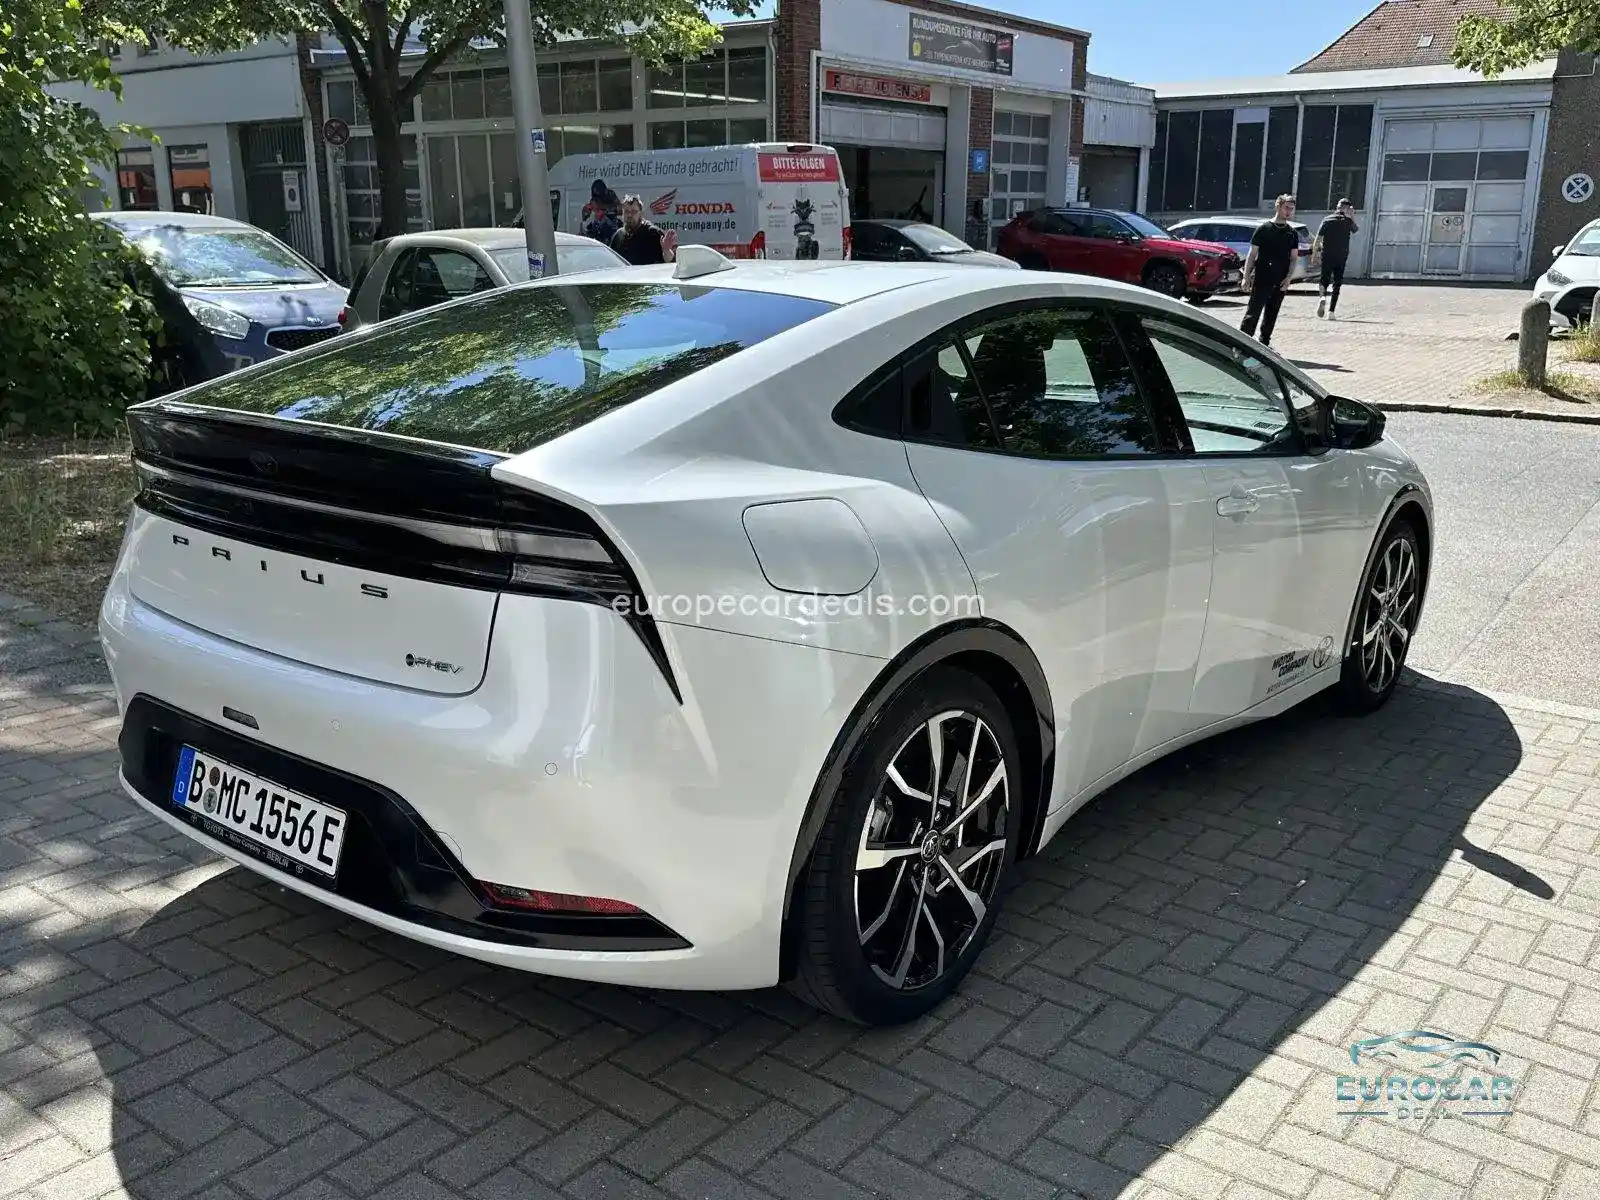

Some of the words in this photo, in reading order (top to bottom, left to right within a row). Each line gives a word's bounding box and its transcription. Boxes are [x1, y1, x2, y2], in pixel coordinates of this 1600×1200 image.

[913, 18, 960, 37] RUNDUMSERVICE
[961, 25, 972, 40] FÜR
[982, 33, 996, 43] AUTO
[579, 165, 598, 179] Hier
[600, 162, 620, 178] wird
[622, 160, 652, 177] DEINE
[655, 159, 686, 175] Honda
[688, 157, 738, 177] gebracht!
[772, 157, 796, 169] BITTE
[796, 157, 825, 170] FOLGEN
[675, 203, 735, 215] HONDA
[173, 535, 388, 599] PRIUS
[415, 656, 463, 675] PHEV
[1272, 650, 1296, 670] MOTOR
[1279, 652, 1310, 678] COMPANY
[188, 759, 206, 803] B
[203, 817, 225, 838] TOYOTA
[266, 850, 290, 868] BERLIN
